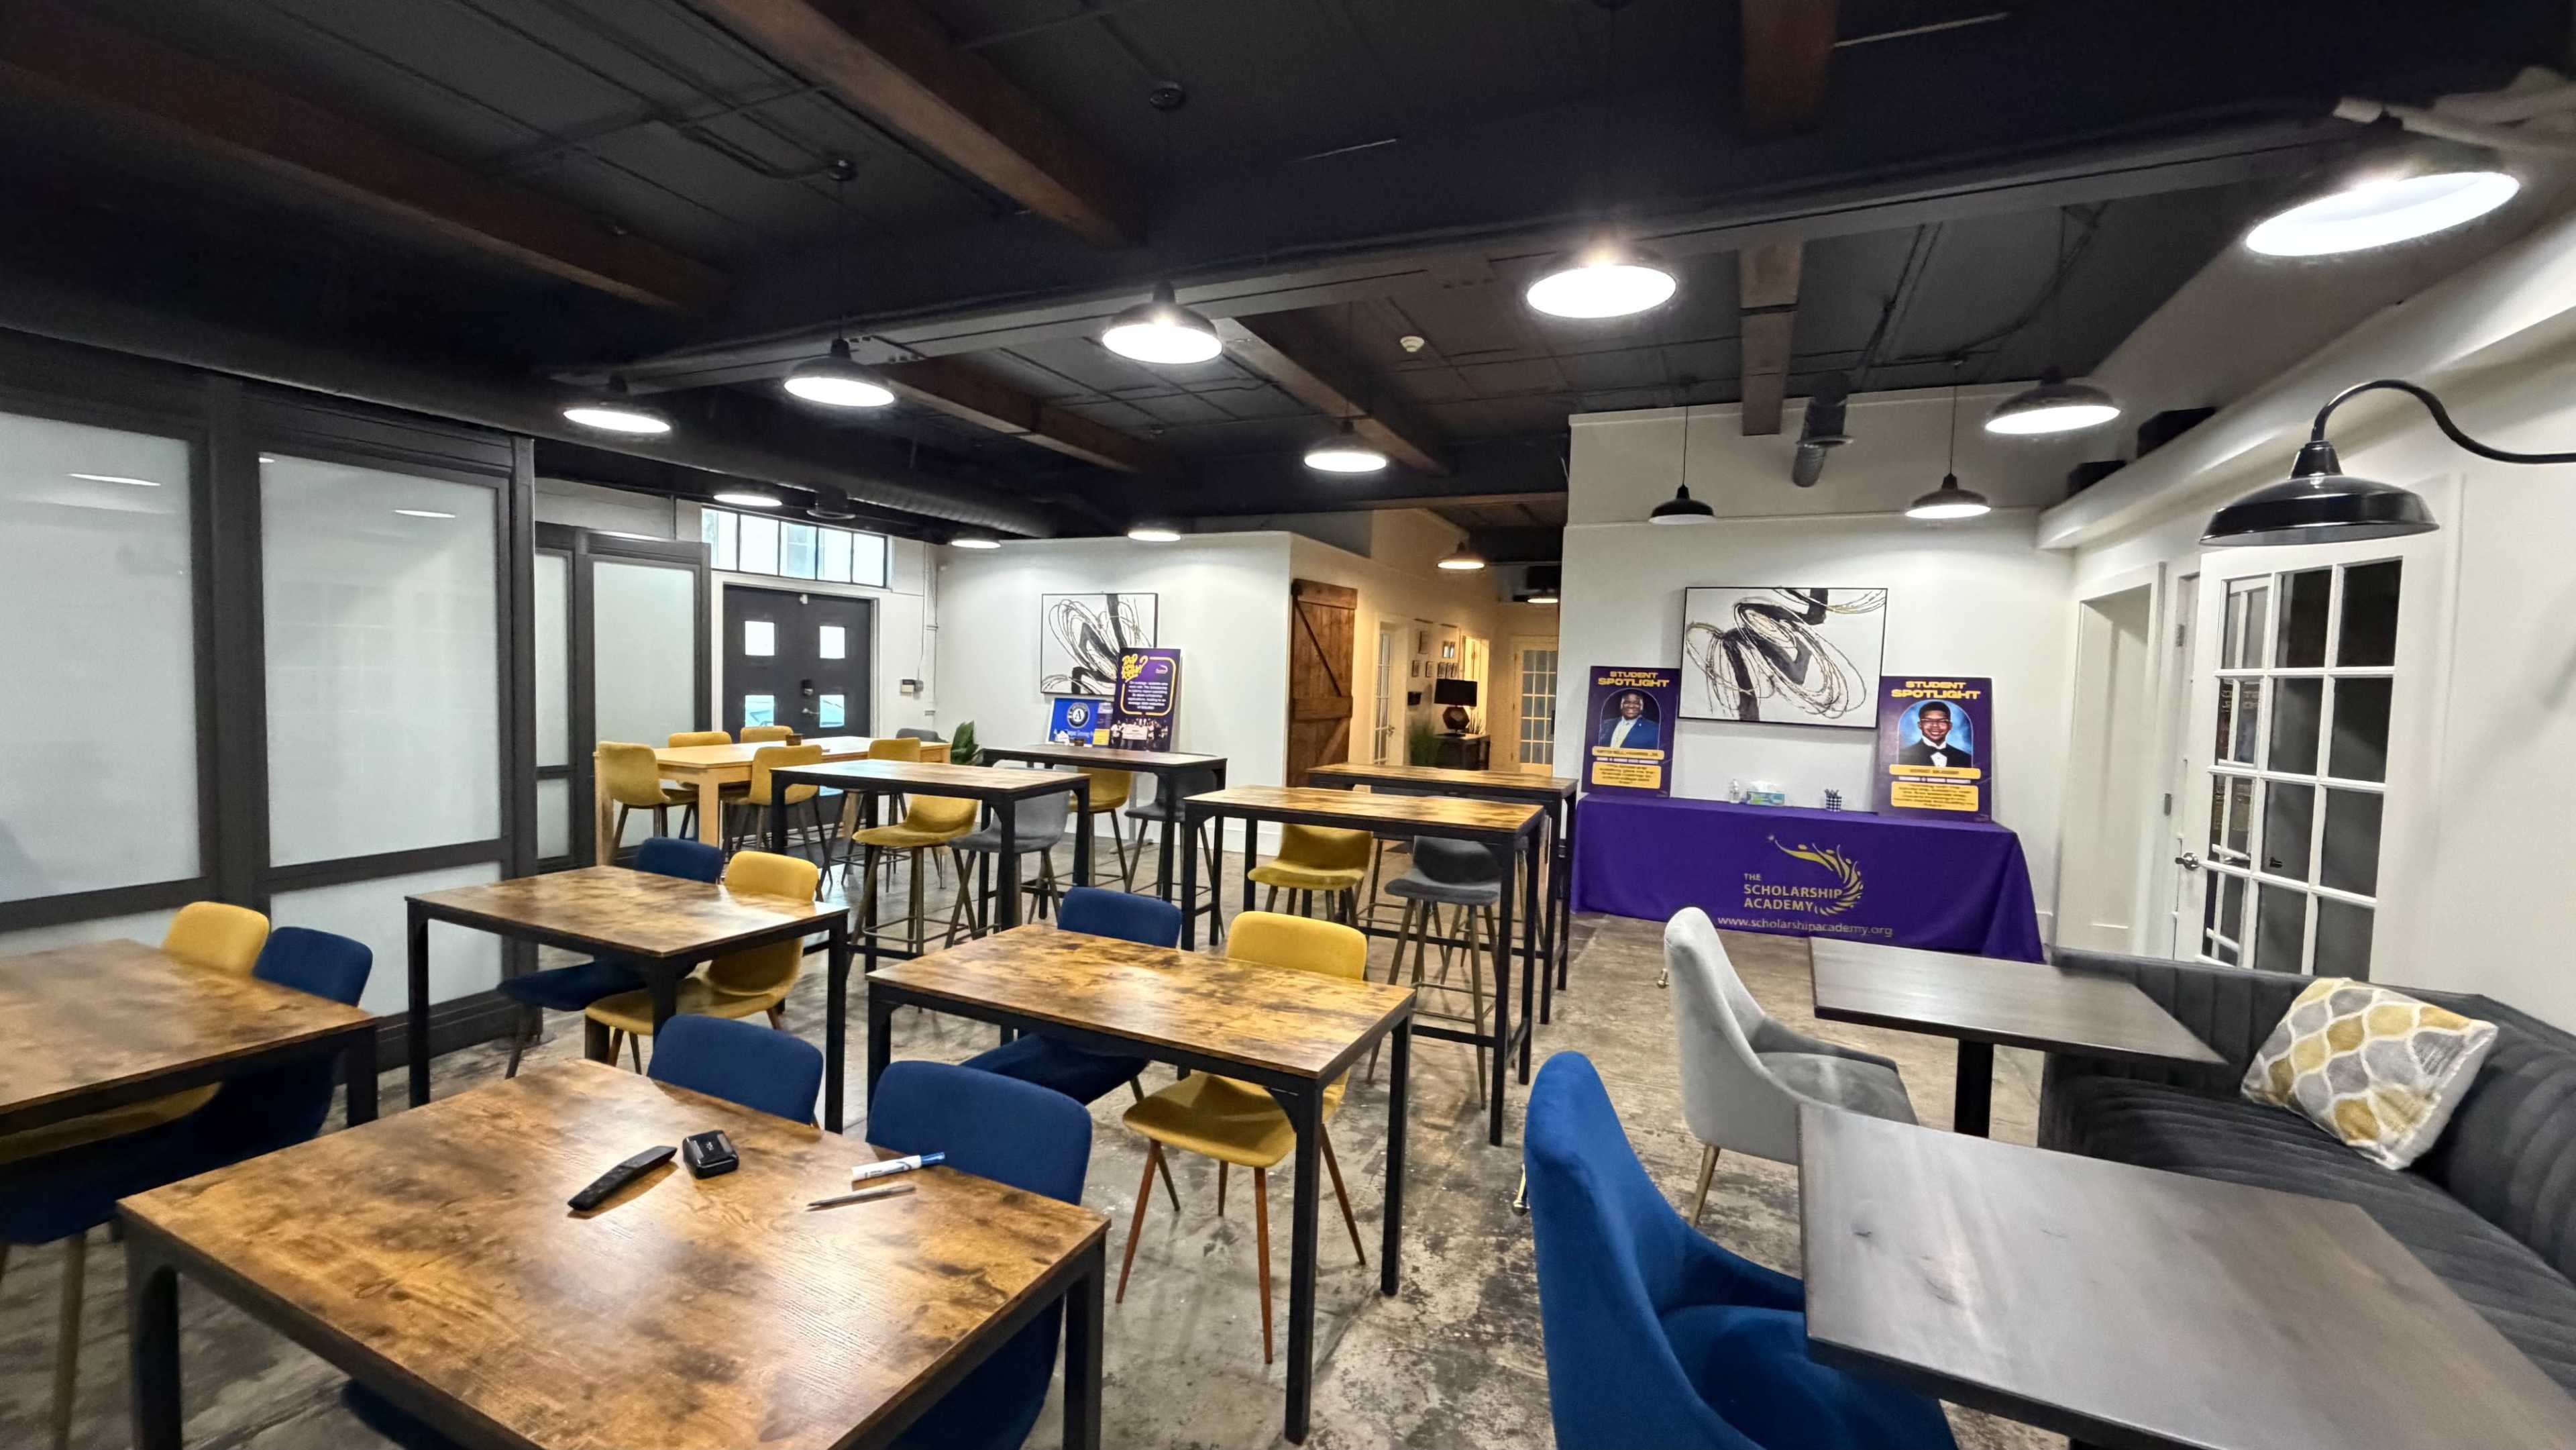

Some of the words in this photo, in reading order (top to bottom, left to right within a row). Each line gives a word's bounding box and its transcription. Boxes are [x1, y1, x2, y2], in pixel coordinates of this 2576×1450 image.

[1598, 678, 1670, 687] SPOTLIGHT
[1891, 689, 1981, 699] SPOTLIGHT
[1744, 873, 1762, 881] THE
[1743, 884, 1843, 898] SCHOLARSHIP
[1744, 898, 1815, 912] ACADEMY
[1717, 917, 1893, 937] www.scholarshipacademy.org
